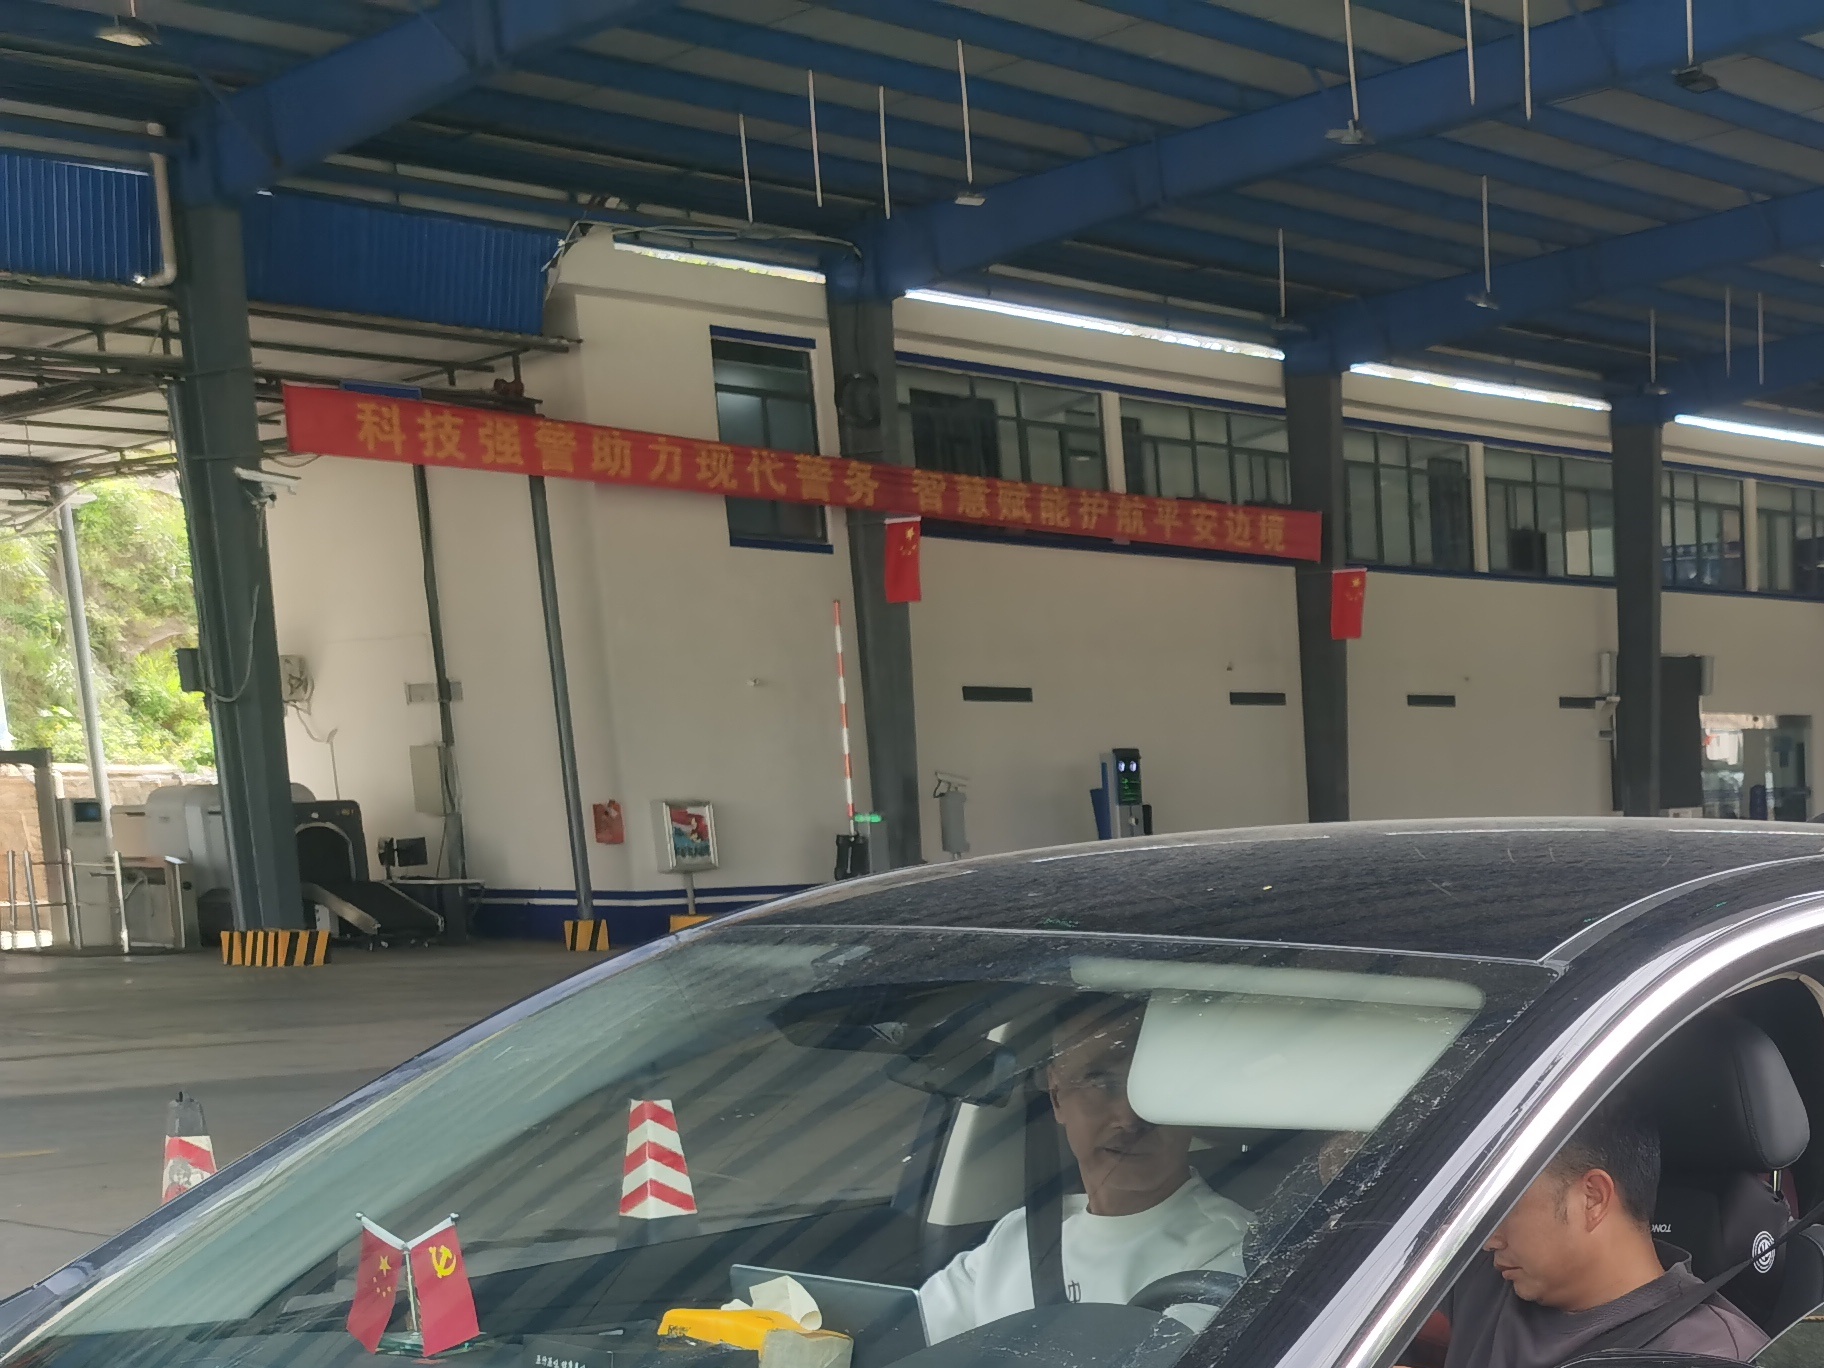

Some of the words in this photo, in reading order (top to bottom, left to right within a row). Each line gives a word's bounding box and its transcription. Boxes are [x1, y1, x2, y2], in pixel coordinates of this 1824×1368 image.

[356, 401, 880, 506] 科技强警助力现代警务
[912, 468, 1287, 552] 智慧赋能护航平安边境
